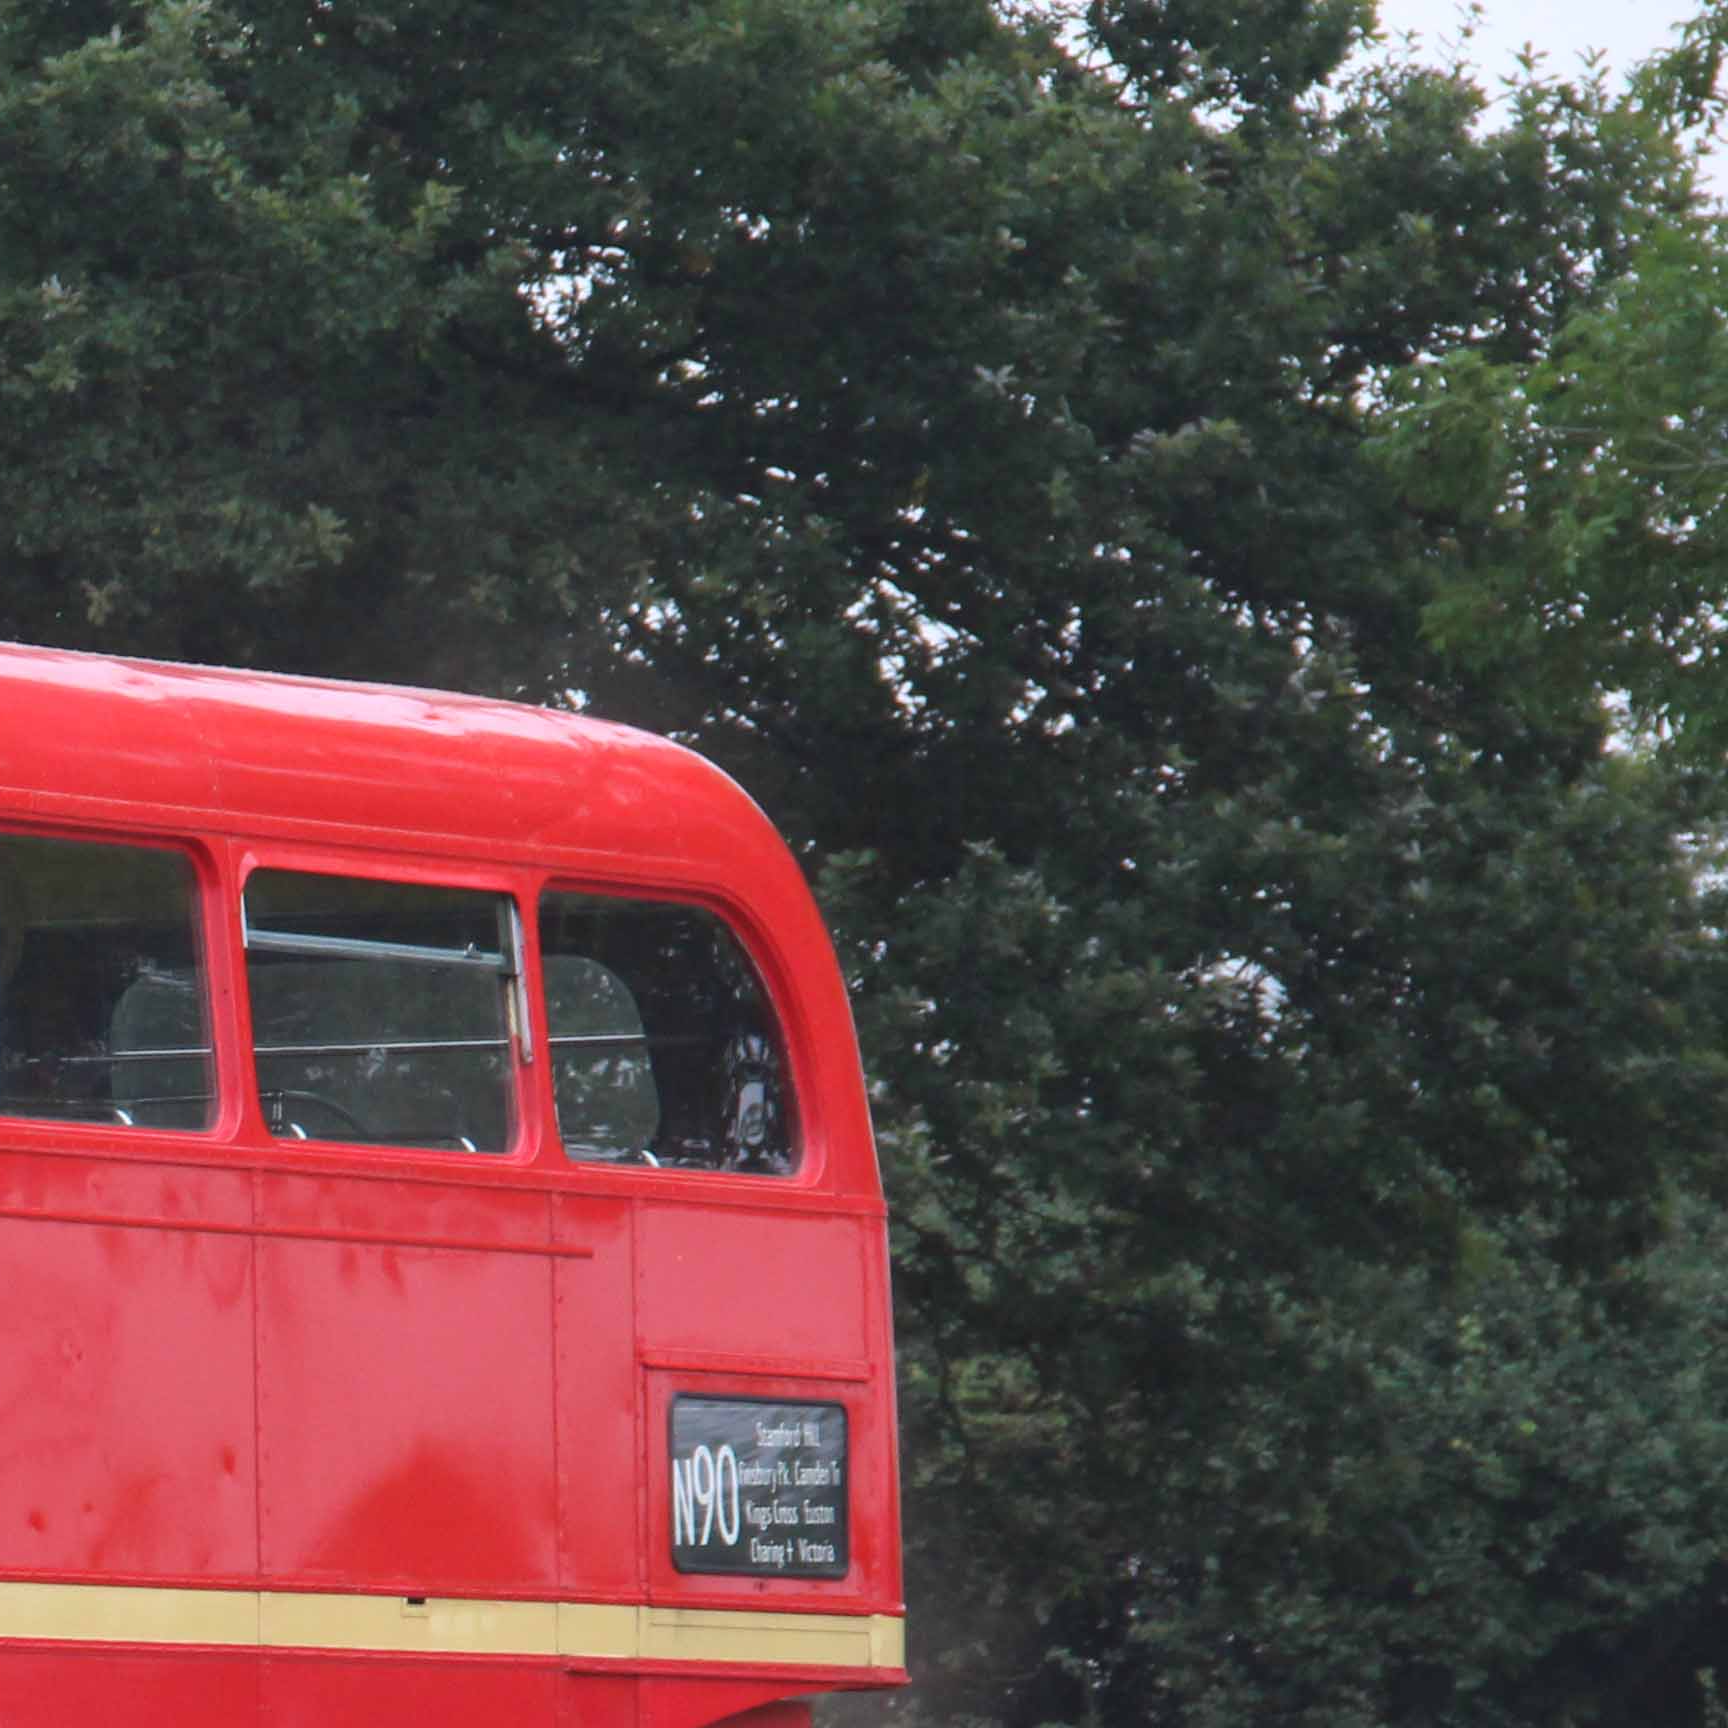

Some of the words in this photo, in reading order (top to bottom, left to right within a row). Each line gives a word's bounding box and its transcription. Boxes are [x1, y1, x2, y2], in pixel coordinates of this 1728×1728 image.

[673, 1445, 740, 1545] N90
[751, 1537, 785, 1568] Charing
[798, 1538, 835, 1563] Victoria
